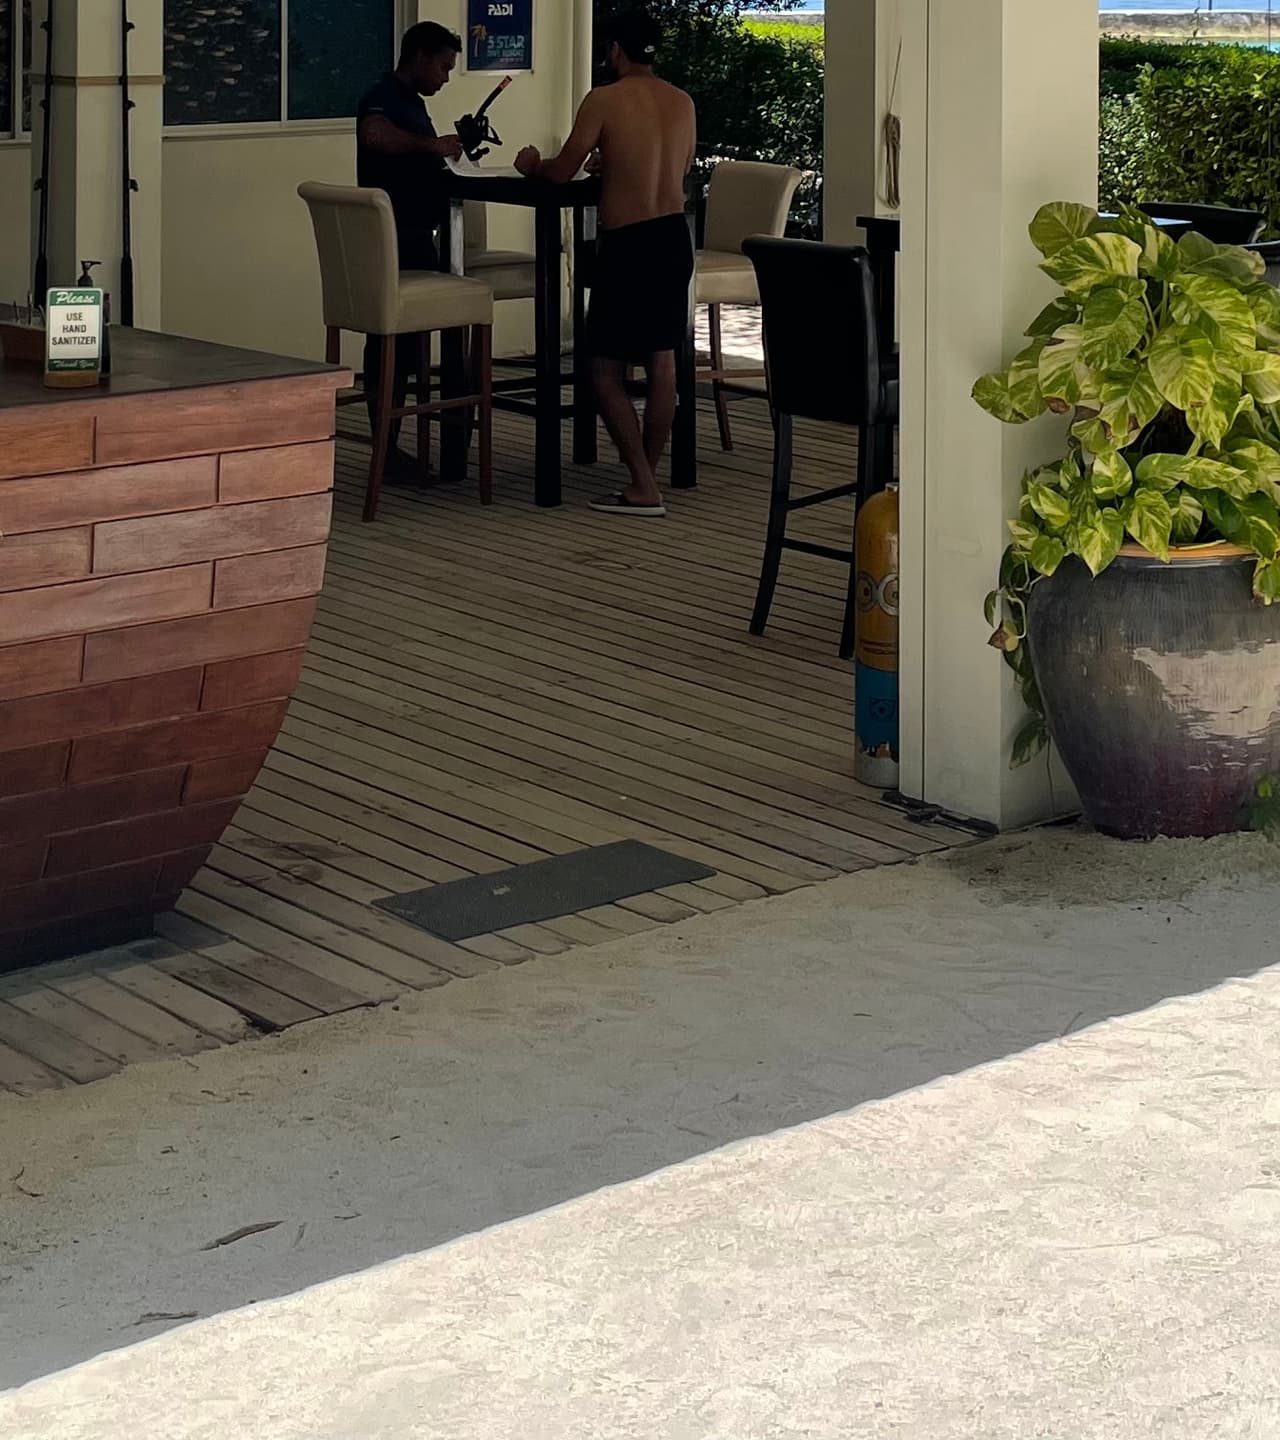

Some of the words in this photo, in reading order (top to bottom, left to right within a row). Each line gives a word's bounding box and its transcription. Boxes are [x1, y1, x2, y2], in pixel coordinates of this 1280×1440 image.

[487, 4, 513, 16] PADI
[496, 35, 525, 49] STAR
[55, 291, 96, 304] Please
[66, 312, 83, 321] USE
[62, 324, 87, 333] HAND
[51, 336, 97, 345] SANITIZER
